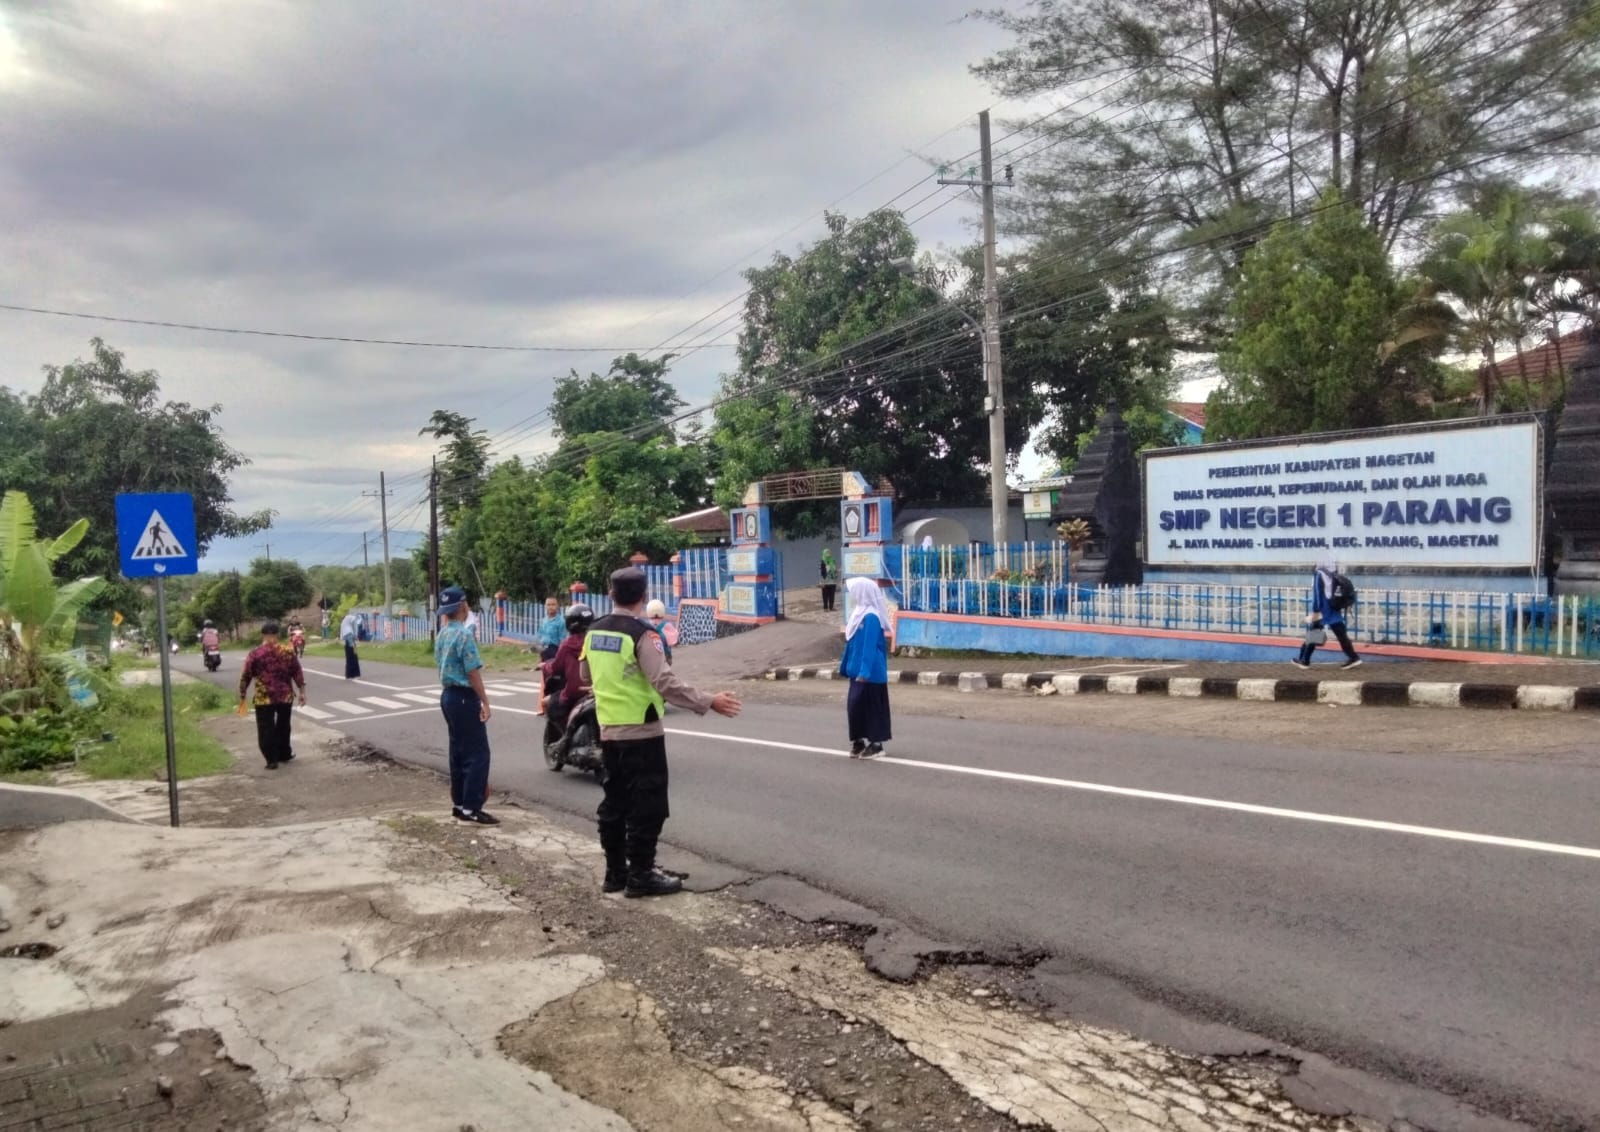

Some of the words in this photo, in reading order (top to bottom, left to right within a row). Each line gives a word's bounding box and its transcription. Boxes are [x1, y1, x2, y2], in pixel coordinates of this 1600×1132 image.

[1208, 463, 1281, 479] PEMERINTAH
[1284, 457, 1361, 474] KABUPATEN
[1366, 451, 1435, 468] MAGETAN
[1173, 489, 1204, 501] DINAS
[1206, 485, 1276, 499] PENDIDIKAN,
[1278, 479, 1368, 495] KEPEMUDAAN,
[1371, 477, 1399, 491] DAN
[1402, 475, 1442, 490] OLAH
[1445, 472, 1488, 487] RAGA
[1159, 508, 1211, 532] SMP
[1219, 503, 1327, 530] NEGERI
[1337, 502, 1352, 527] 1
[1363, 496, 1512, 526] PARANG
[1168, 539, 1182, 549] JL.
[1184, 538, 1210, 549] RAYA
[1212, 538, 1254, 550] PARANG
[1264, 537, 1329, 550] LEMBEYAN,
[1332, 536, 1362, 548] KEC.
[1365, 535, 1424, 549] PARANG,
[1427, 534, 1499, 548] MAGETAN
[592, 635, 620, 651] POLISI
